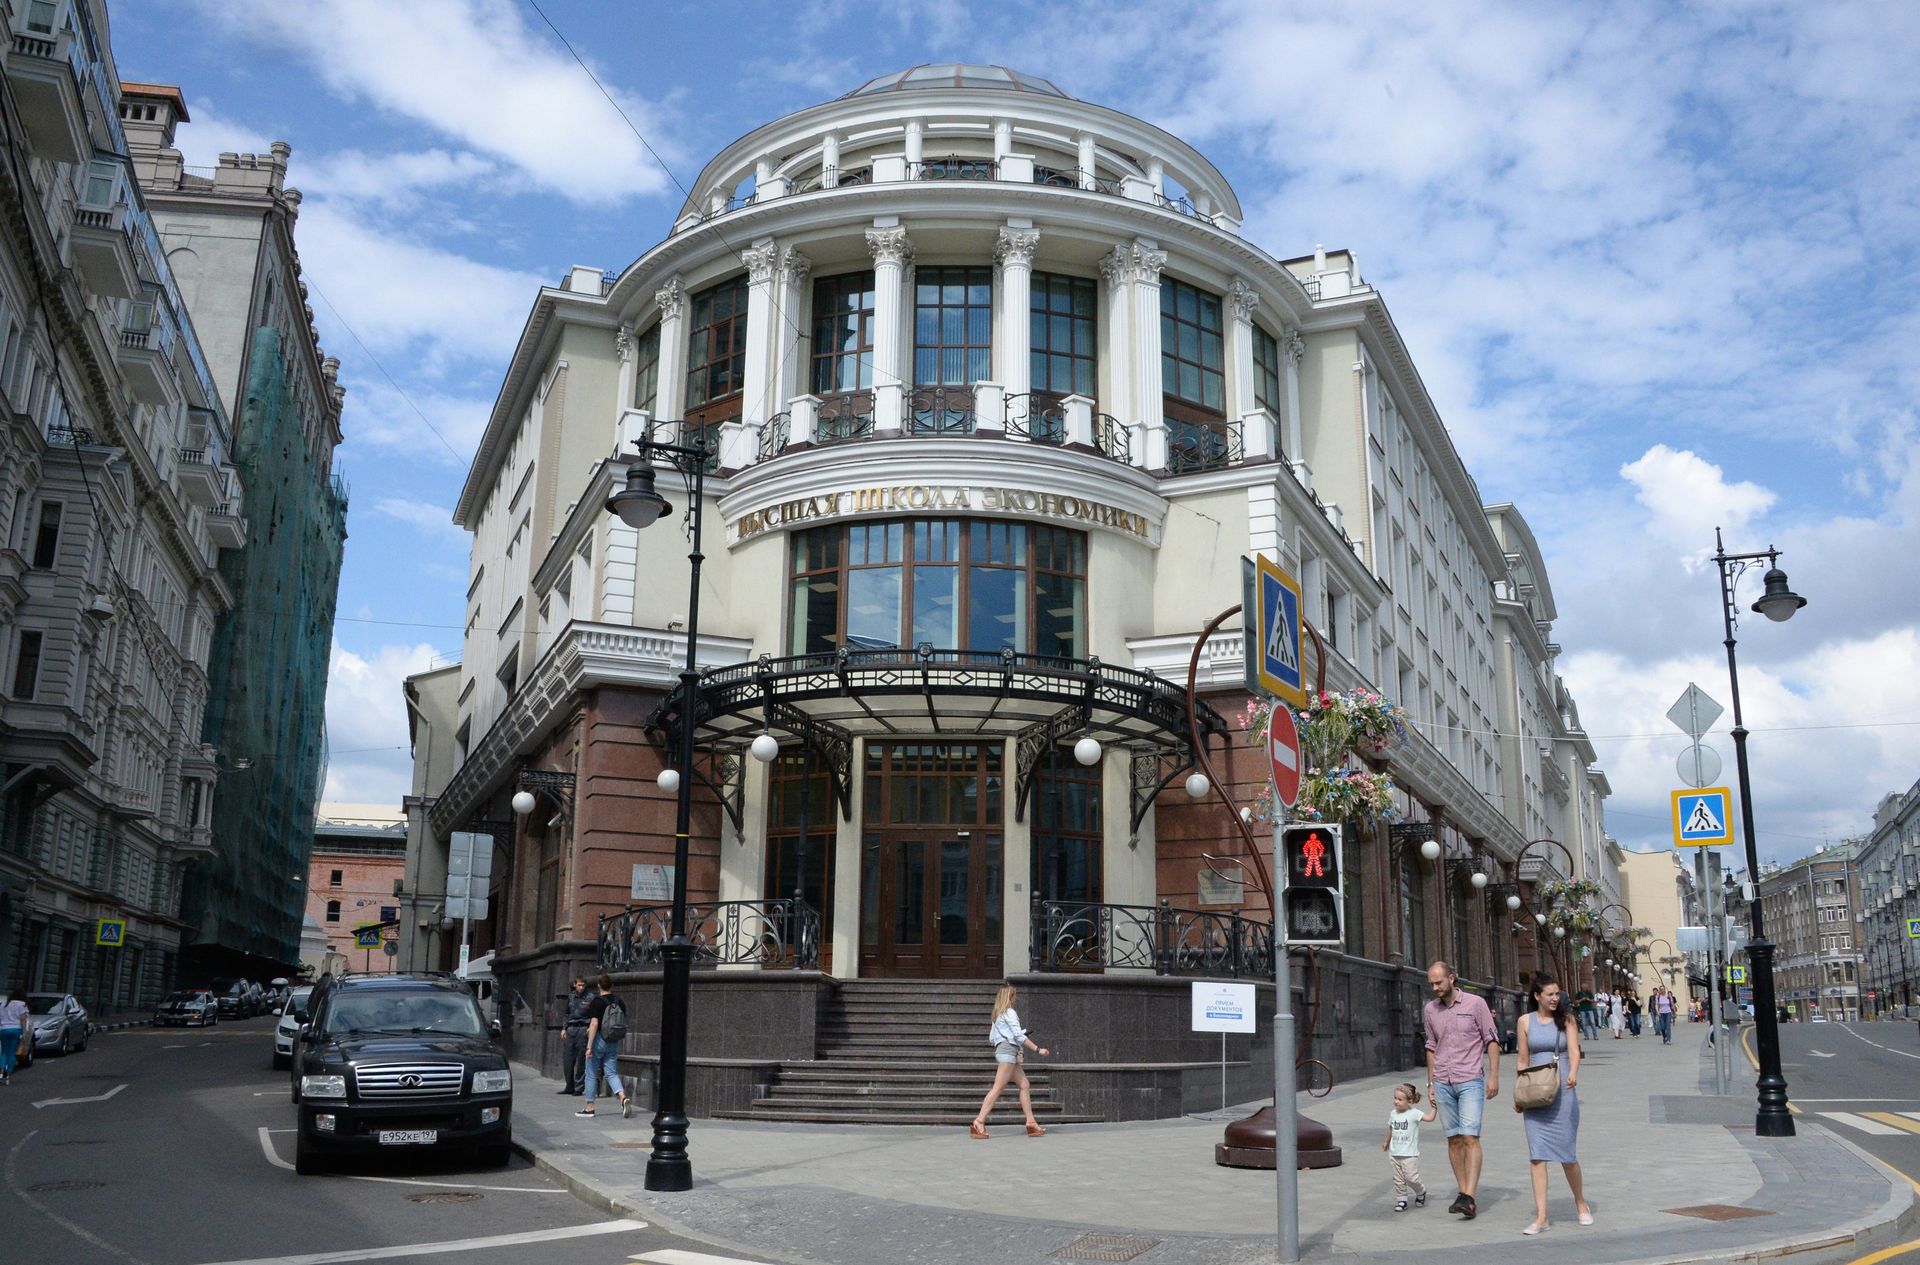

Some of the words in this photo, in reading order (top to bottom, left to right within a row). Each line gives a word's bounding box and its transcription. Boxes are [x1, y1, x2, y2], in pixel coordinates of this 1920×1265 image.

[737, 493, 841, 538] ВЫСШАЯ
[854, 486, 971, 511] ШКОЛА
[981, 487, 1149, 537] ЭКОНОМИКИ
